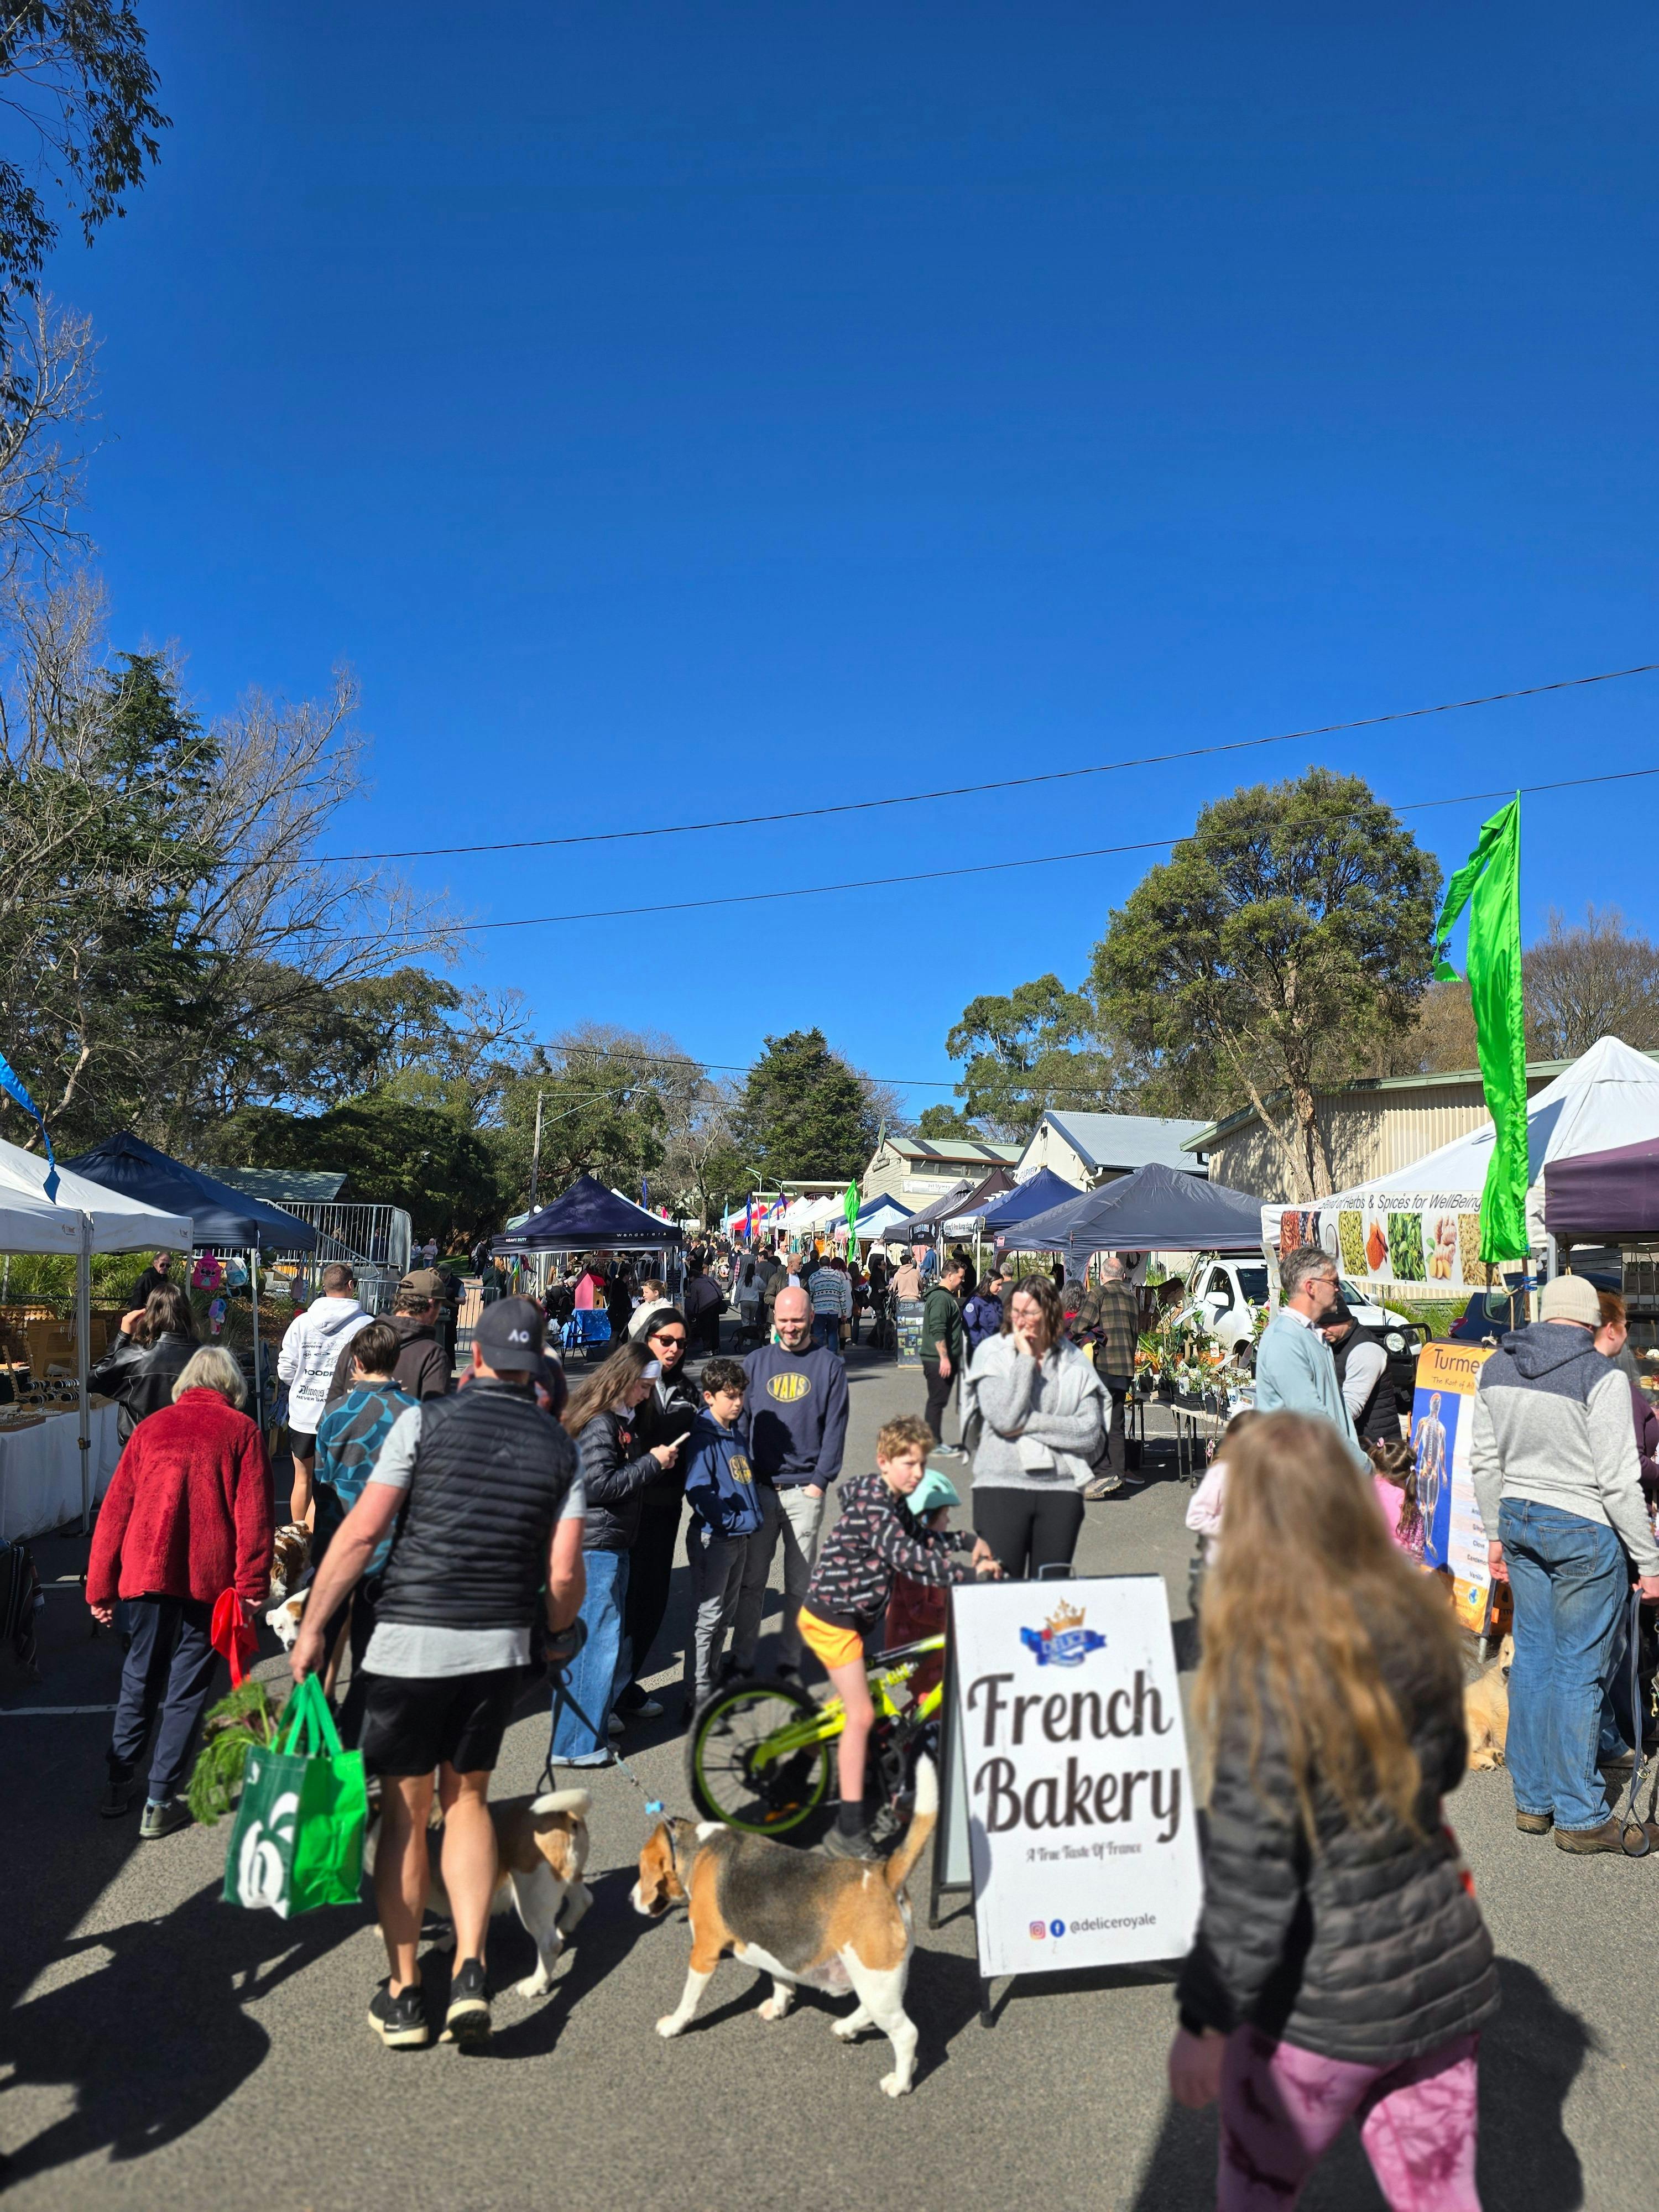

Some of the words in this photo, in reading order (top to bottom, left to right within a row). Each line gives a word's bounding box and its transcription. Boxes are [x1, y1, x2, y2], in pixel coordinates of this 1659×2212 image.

[1343, 1194, 1365, 1209] Herbs
[1368, 1194, 1374, 1208] &
[1378, 1193, 1411, 1212] Spices
[1411, 1194, 1429, 1209] for
[1430, 1193, 1483, 1212] WellBeing
[1434, 1348, 1483, 1374] Turme
[774, 1374, 806, 1399] VANS
[1459, 1380, 1465, 1390] of
[1473, 1540, 1485, 1549] Clove
[967, 1670, 1173, 1747] French
[974, 1756, 1182, 1844] Bakery
[1026, 1848, 1035, 1863] A
[1037, 1846, 1060, 1861] True
[1062, 1845, 1089, 1859] Taste
[1092, 1842, 1104, 1861] Of
[1107, 1840, 1142, 1855] France
[1070, 1913, 1157, 1934] @deliceroyale
